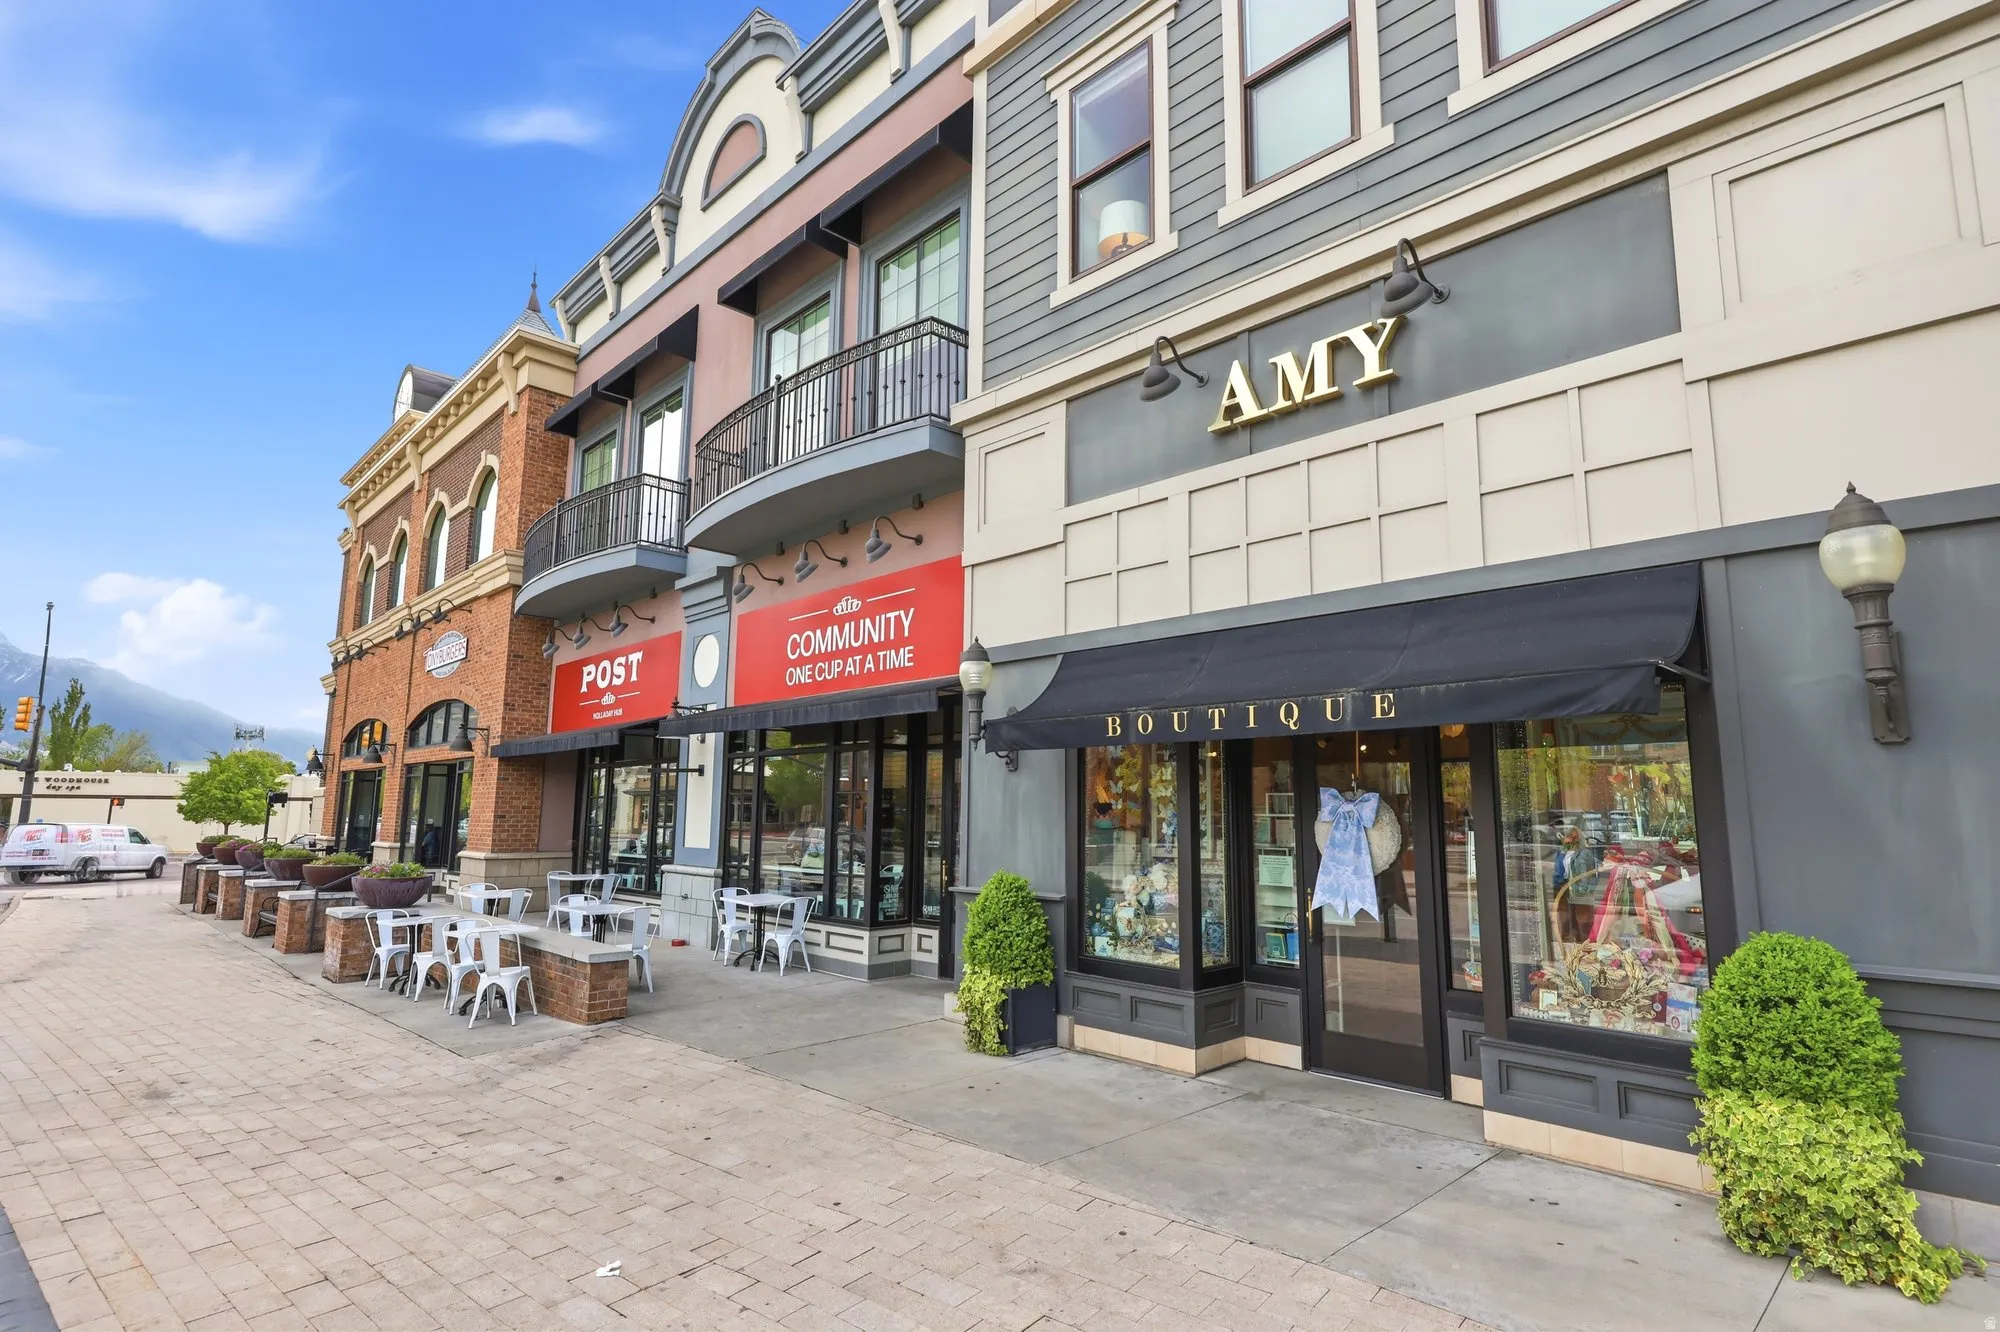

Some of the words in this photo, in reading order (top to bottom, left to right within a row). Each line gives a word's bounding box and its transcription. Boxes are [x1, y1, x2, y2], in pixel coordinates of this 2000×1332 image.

[1207, 315, 1408, 435] AMY
[786, 607, 915, 660] COMMUNITY
[423, 640, 468, 672] TONYBURGERS
[580, 650, 644, 693] POST
[785, 664, 813, 686] ONE
[815, 659, 843, 681] CUP
[844, 655, 862, 677] AT
[863, 653, 875, 674] A
[877, 646, 914, 671] TIME
[592, 710, 614, 720] HOLLADAY
[613, 708, 623, 717] HUB
[1105, 693, 1396, 737] BOUTIQUE
